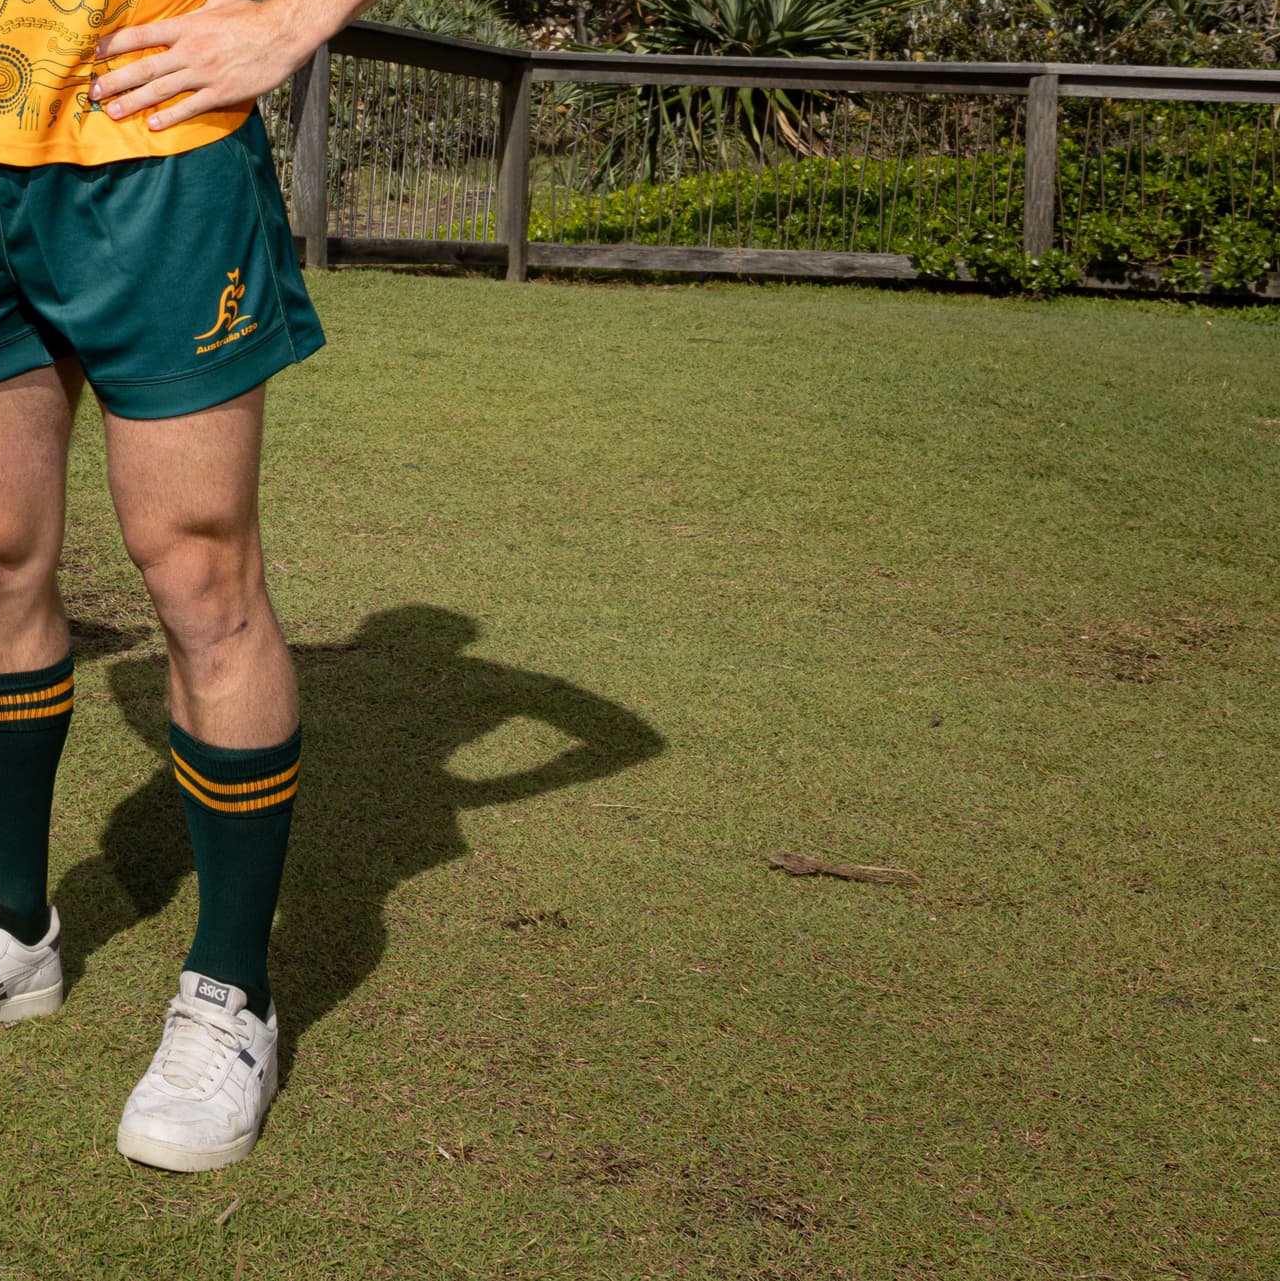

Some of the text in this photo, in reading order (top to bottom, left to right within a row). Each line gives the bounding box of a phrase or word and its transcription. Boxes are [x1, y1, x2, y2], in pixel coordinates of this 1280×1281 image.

[196, 322, 258, 355] Australia U20
[199, 982, 227, 1001] asics
